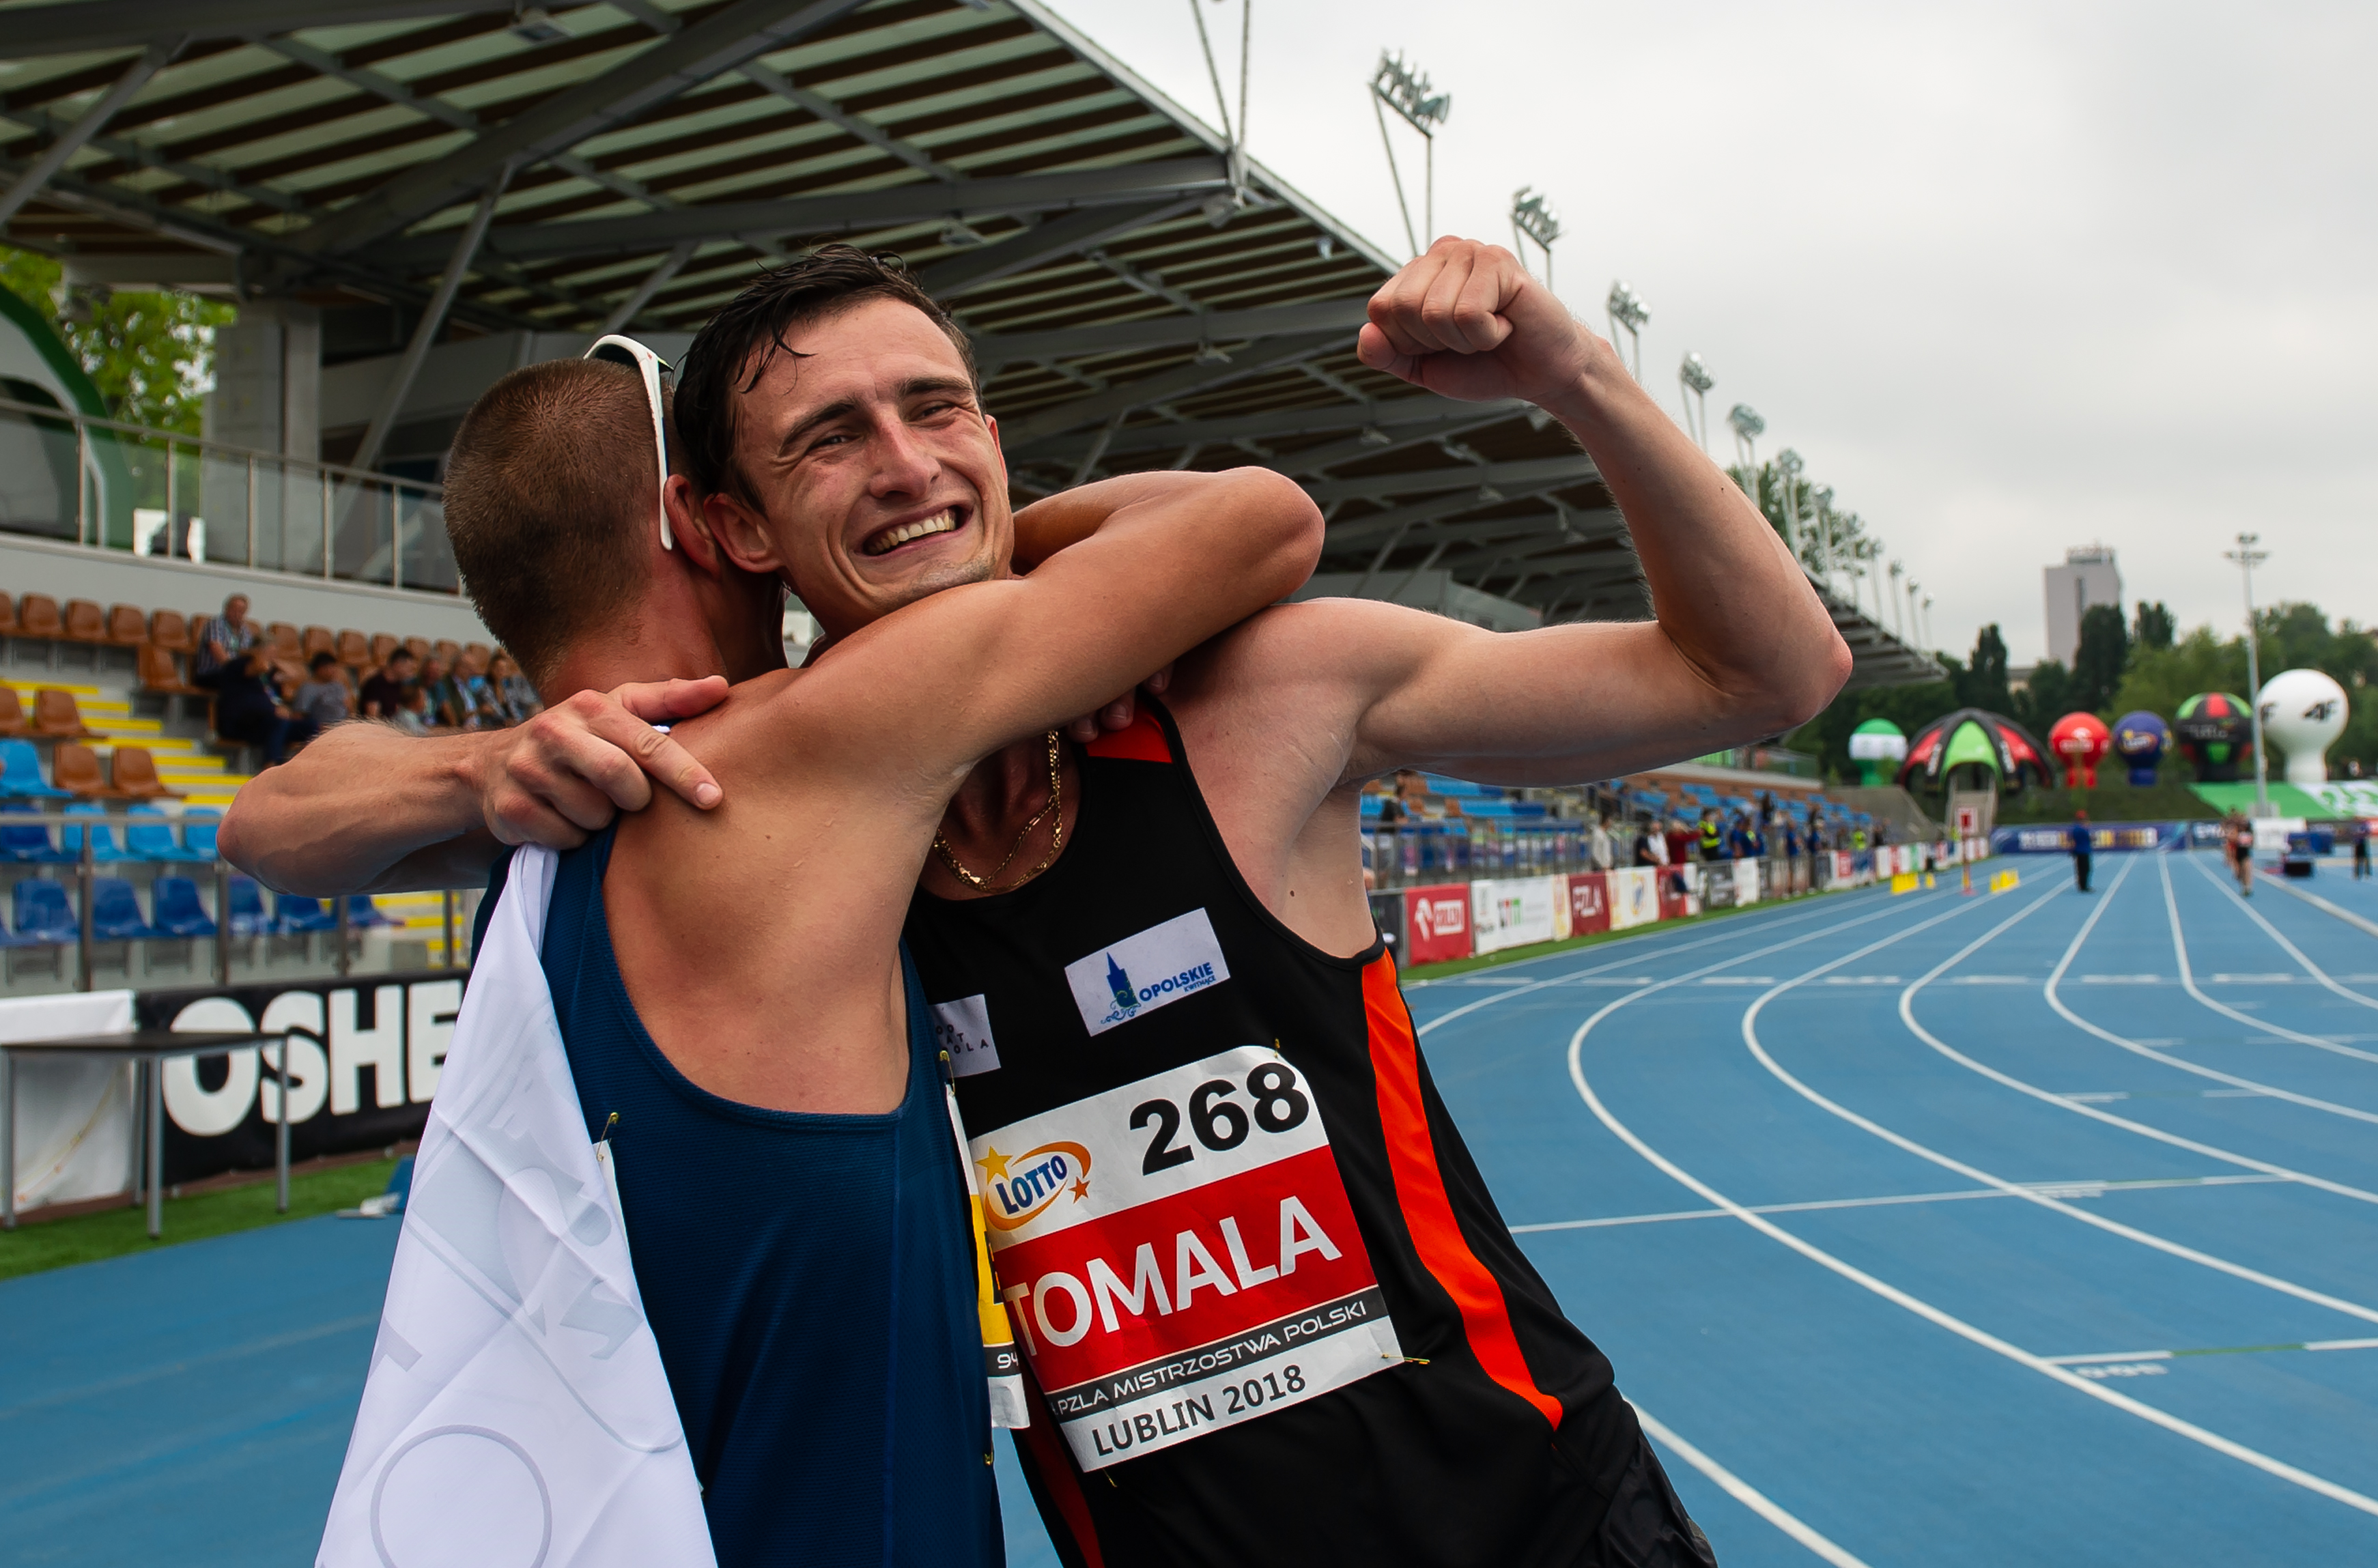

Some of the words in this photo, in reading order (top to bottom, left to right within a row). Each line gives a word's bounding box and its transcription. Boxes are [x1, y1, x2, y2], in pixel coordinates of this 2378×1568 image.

[1139, 962, 1214, 1001] OPOLSKIE
[942, 1038, 989, 1054] OLA
[1129, 1061, 1310, 1176] 268
[995, 1155, 1067, 1215] LOTTO
[1002, 1195, 1344, 1357] TOMALA
[1058, 1388, 1109, 1416] PZLA
[1114, 1333, 1282, 1399] MISTRZOSTWA
[1283, 1300, 1368, 1343] POLSKI
[1092, 1393, 1216, 1457] LUBLIN
[1221, 1364, 1306, 1416] 2018
